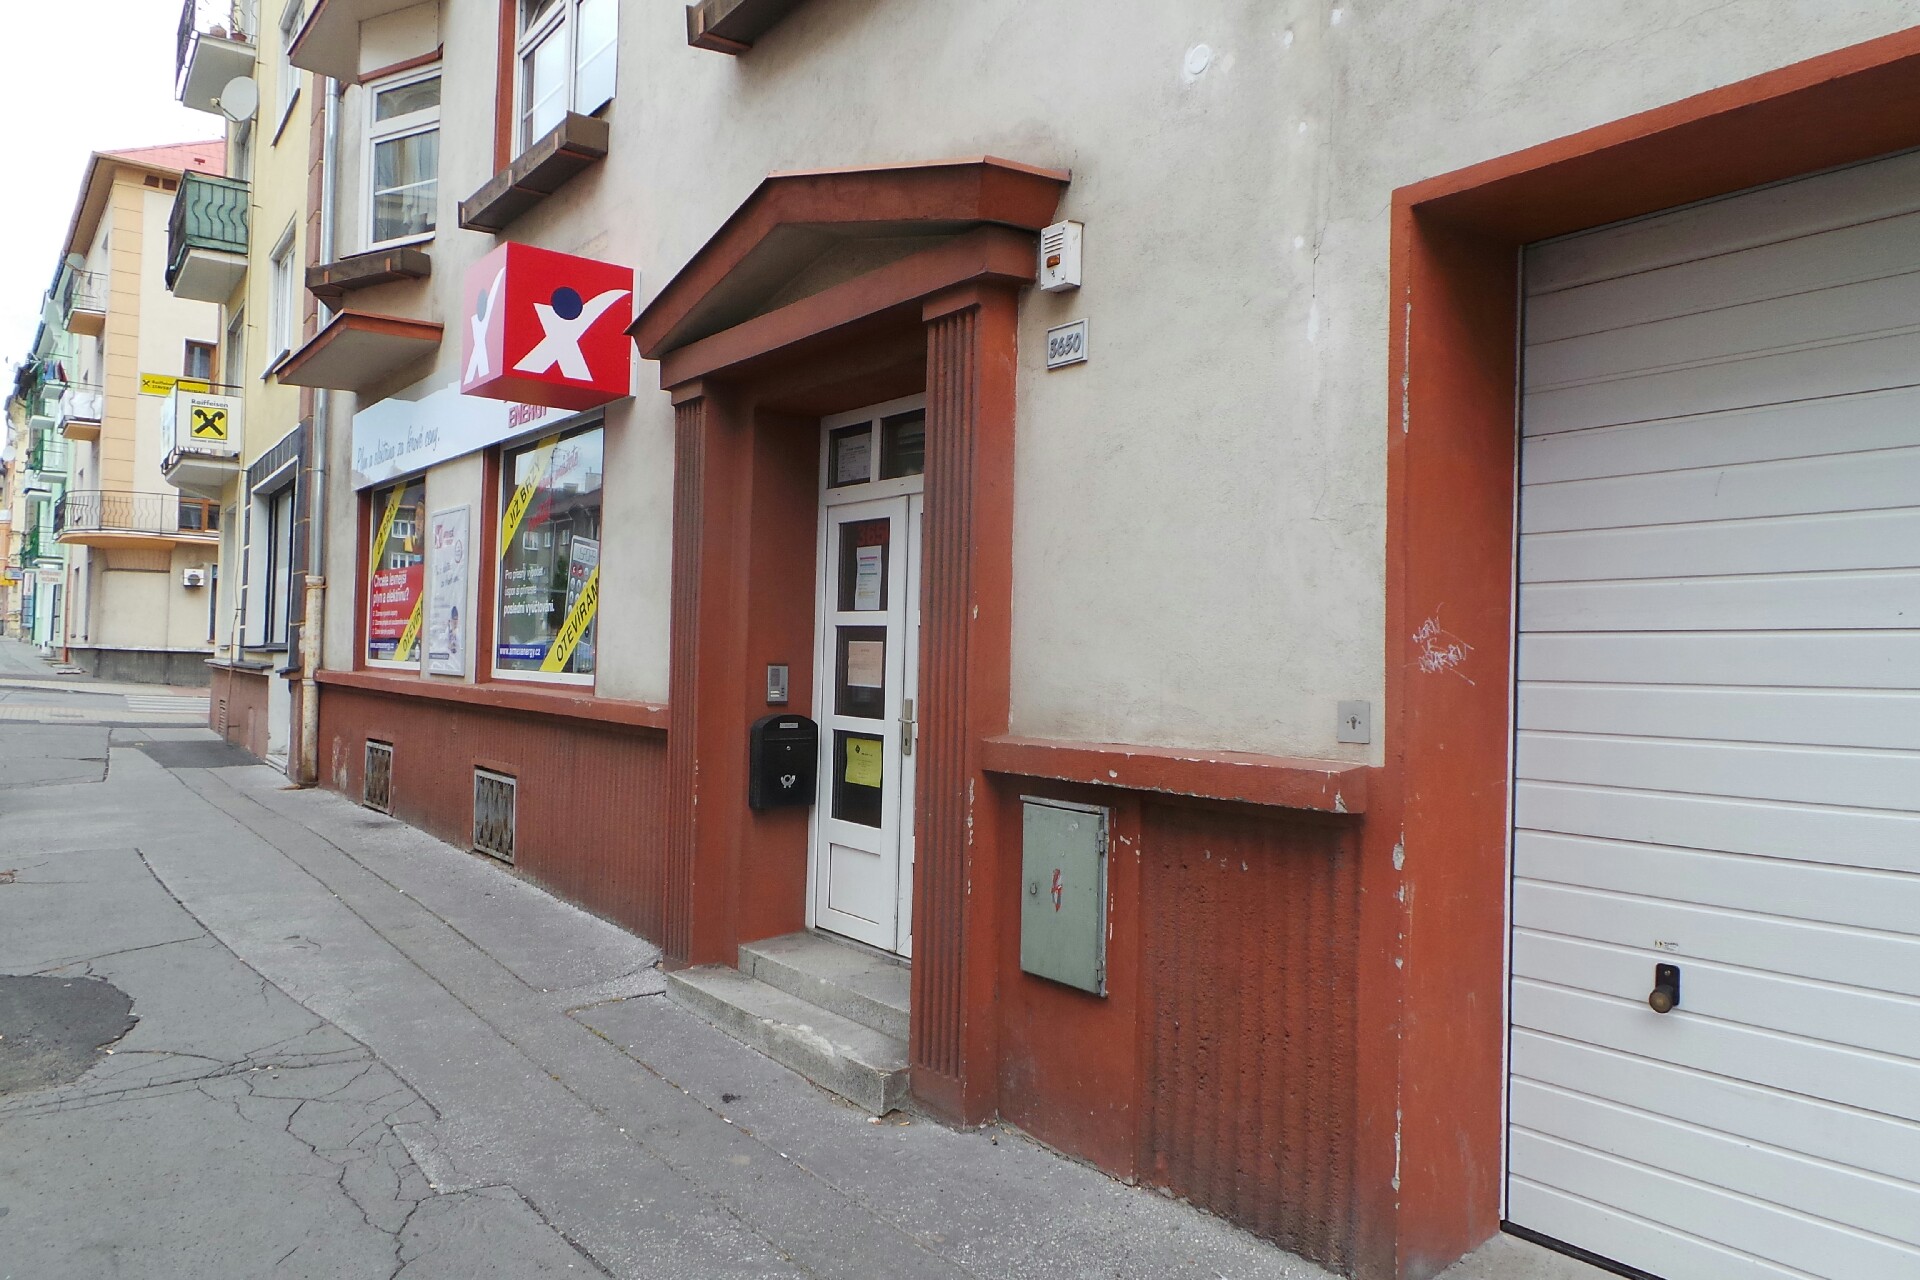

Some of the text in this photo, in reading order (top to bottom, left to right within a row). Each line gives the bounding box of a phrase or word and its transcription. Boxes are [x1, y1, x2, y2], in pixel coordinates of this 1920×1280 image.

[1049, 333, 1082, 359] 3650
[191, 399, 228, 408] Raiffeisen
[509, 499, 521, 529] JIŽ
[520, 455, 541, 504] BRZY
[374, 574, 389, 588] Chcete
[505, 569, 513, 580] Pro
[373, 590, 383, 607] plyn
[383, 592, 386, 603] a
[504, 601, 525, 618] poslední
